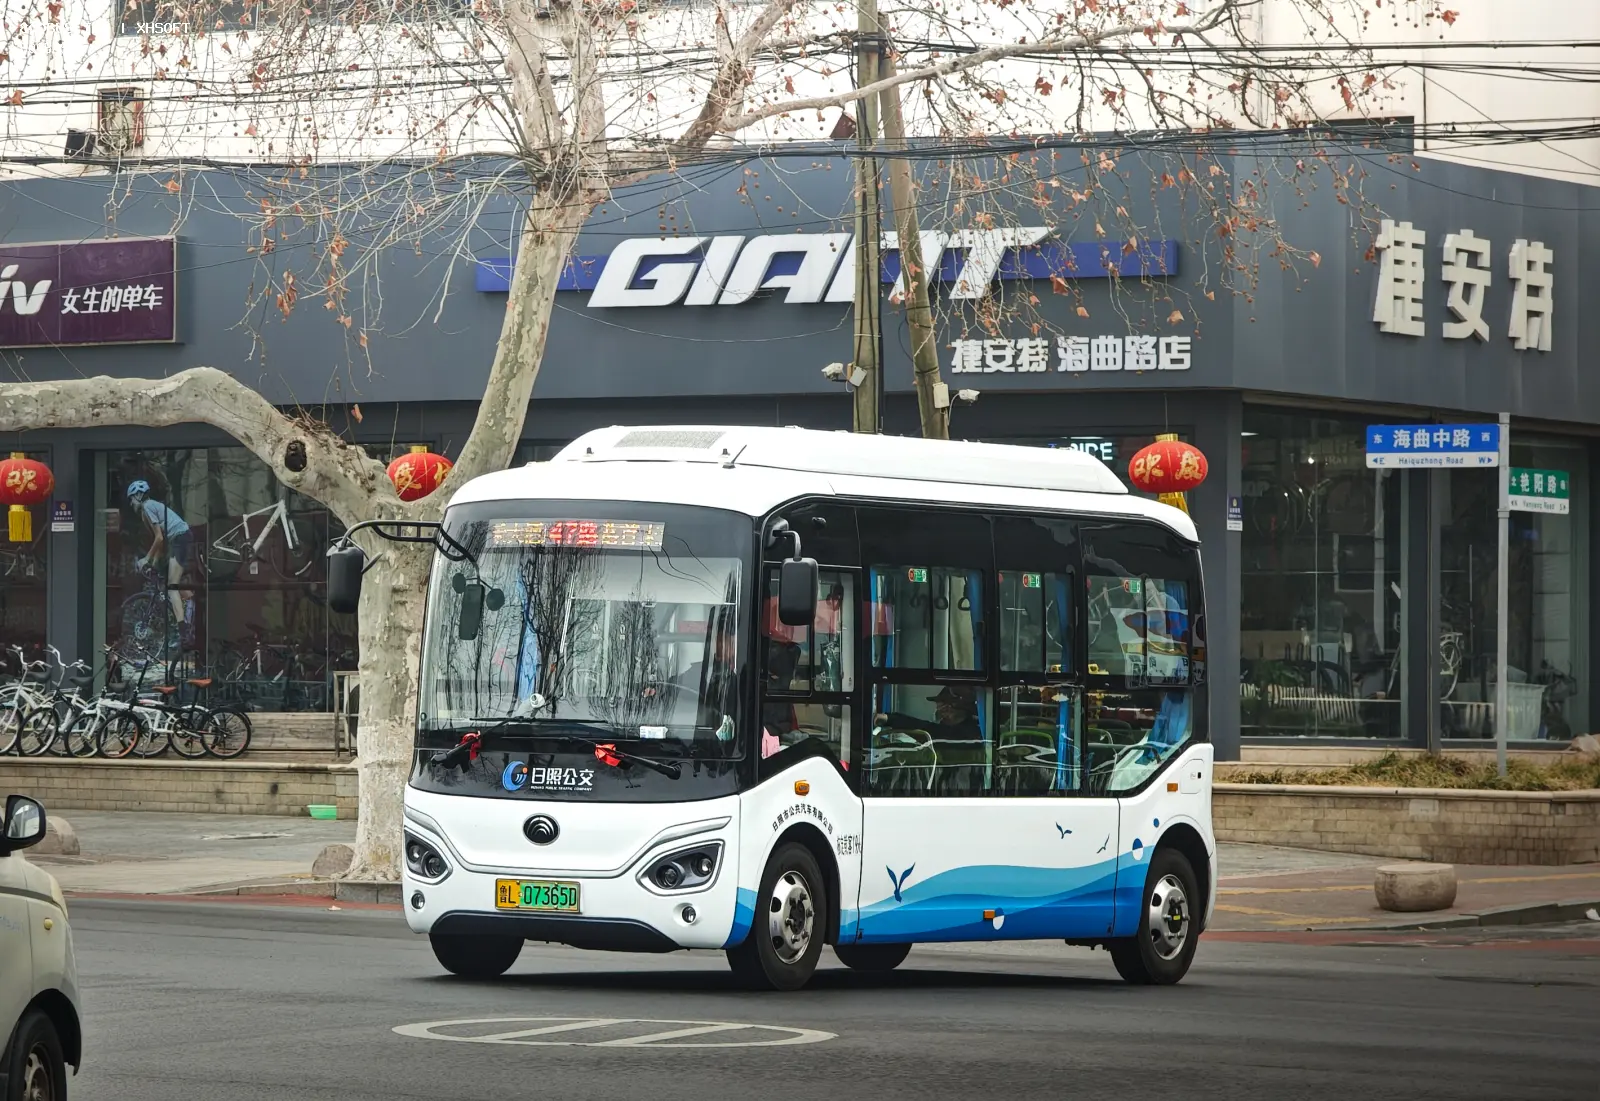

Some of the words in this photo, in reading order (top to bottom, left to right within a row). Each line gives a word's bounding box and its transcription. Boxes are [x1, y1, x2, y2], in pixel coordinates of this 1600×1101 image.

[586, 226, 1051, 308] GIANT
[61, 284, 164, 315] 女生的单车
[951, 336, 1049, 375] 捷安特
[1057, 334, 1192, 372] 海曲路店
[1373, 433, 1383, 444] 东
[1393, 428, 1471, 448] 海曲中路
[1481, 432, 1491, 442] 西
[1379, 457, 1385, 465] E
[1398, 456, 1443, 466] Haiquzhong
[1445, 456, 1464, 465] Road
[1478, 456, 1487, 464] W
[531, 767, 595, 786] 日照公交
[524, 885, 577, 906] 07365D
